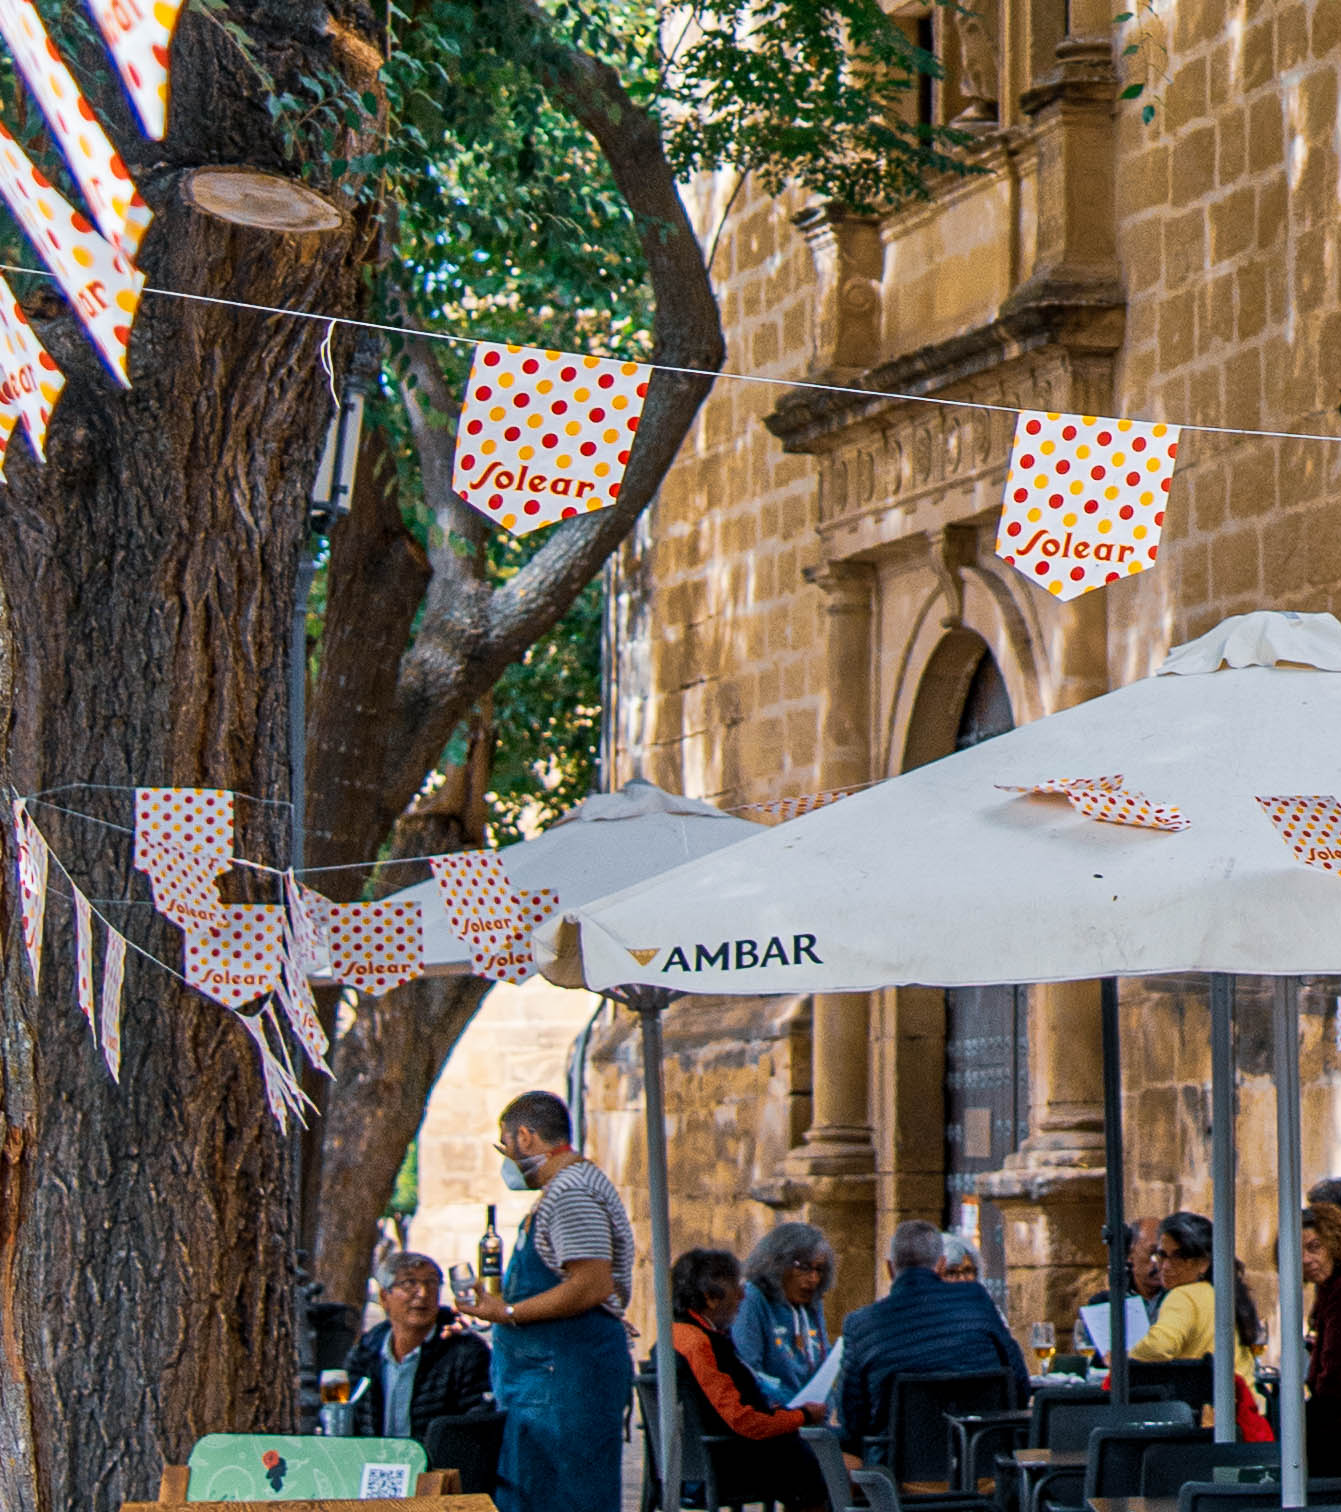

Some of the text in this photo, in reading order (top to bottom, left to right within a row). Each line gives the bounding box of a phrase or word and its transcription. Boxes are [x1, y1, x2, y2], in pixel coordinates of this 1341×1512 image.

[469, 461, 595, 499] Solear
[1016, 529, 1135, 564] Solear
[661, 933, 823, 973] AMBAR
